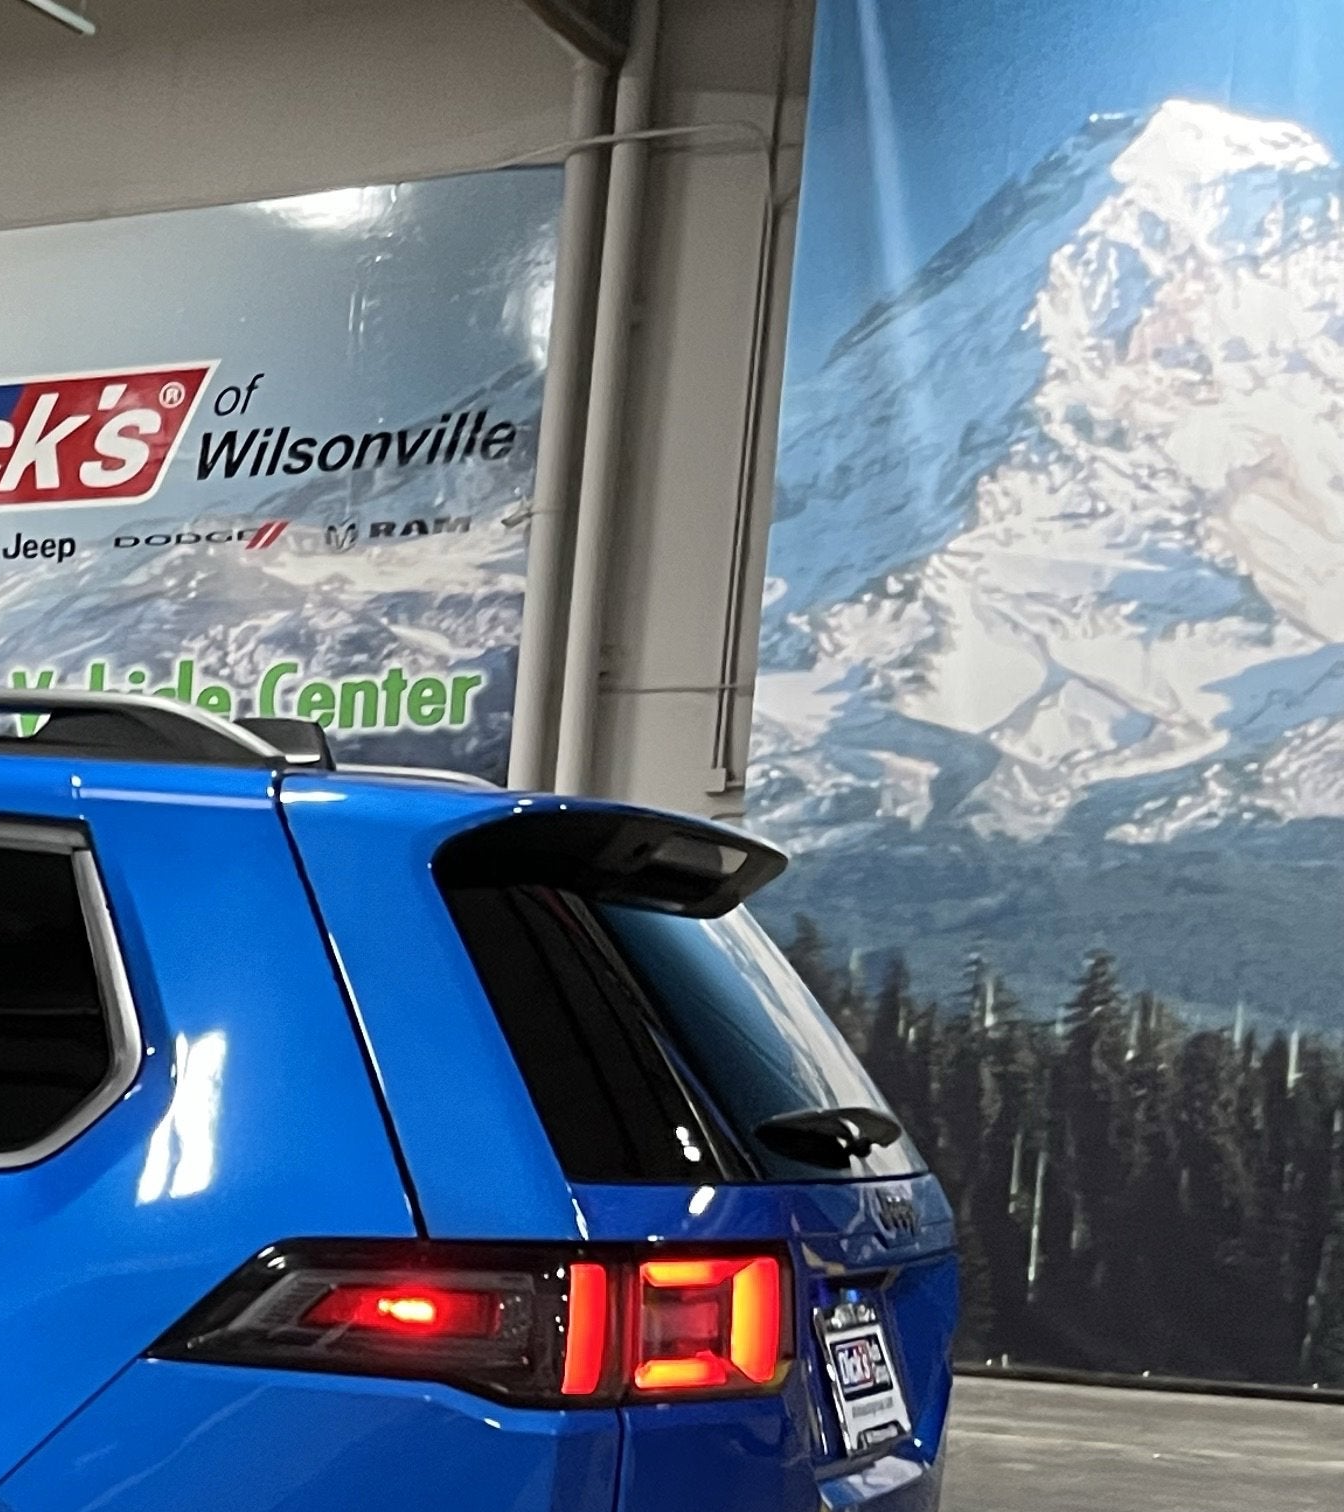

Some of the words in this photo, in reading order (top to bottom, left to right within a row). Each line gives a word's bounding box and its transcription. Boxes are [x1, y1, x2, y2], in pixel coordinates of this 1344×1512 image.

[214, 373, 264, 416] of
[197, 409, 517, 481] Wilsonville
[1, 533, 76, 563] Jeep
[370, 516, 472, 538] RAM
[258, 662, 482, 729] Center
